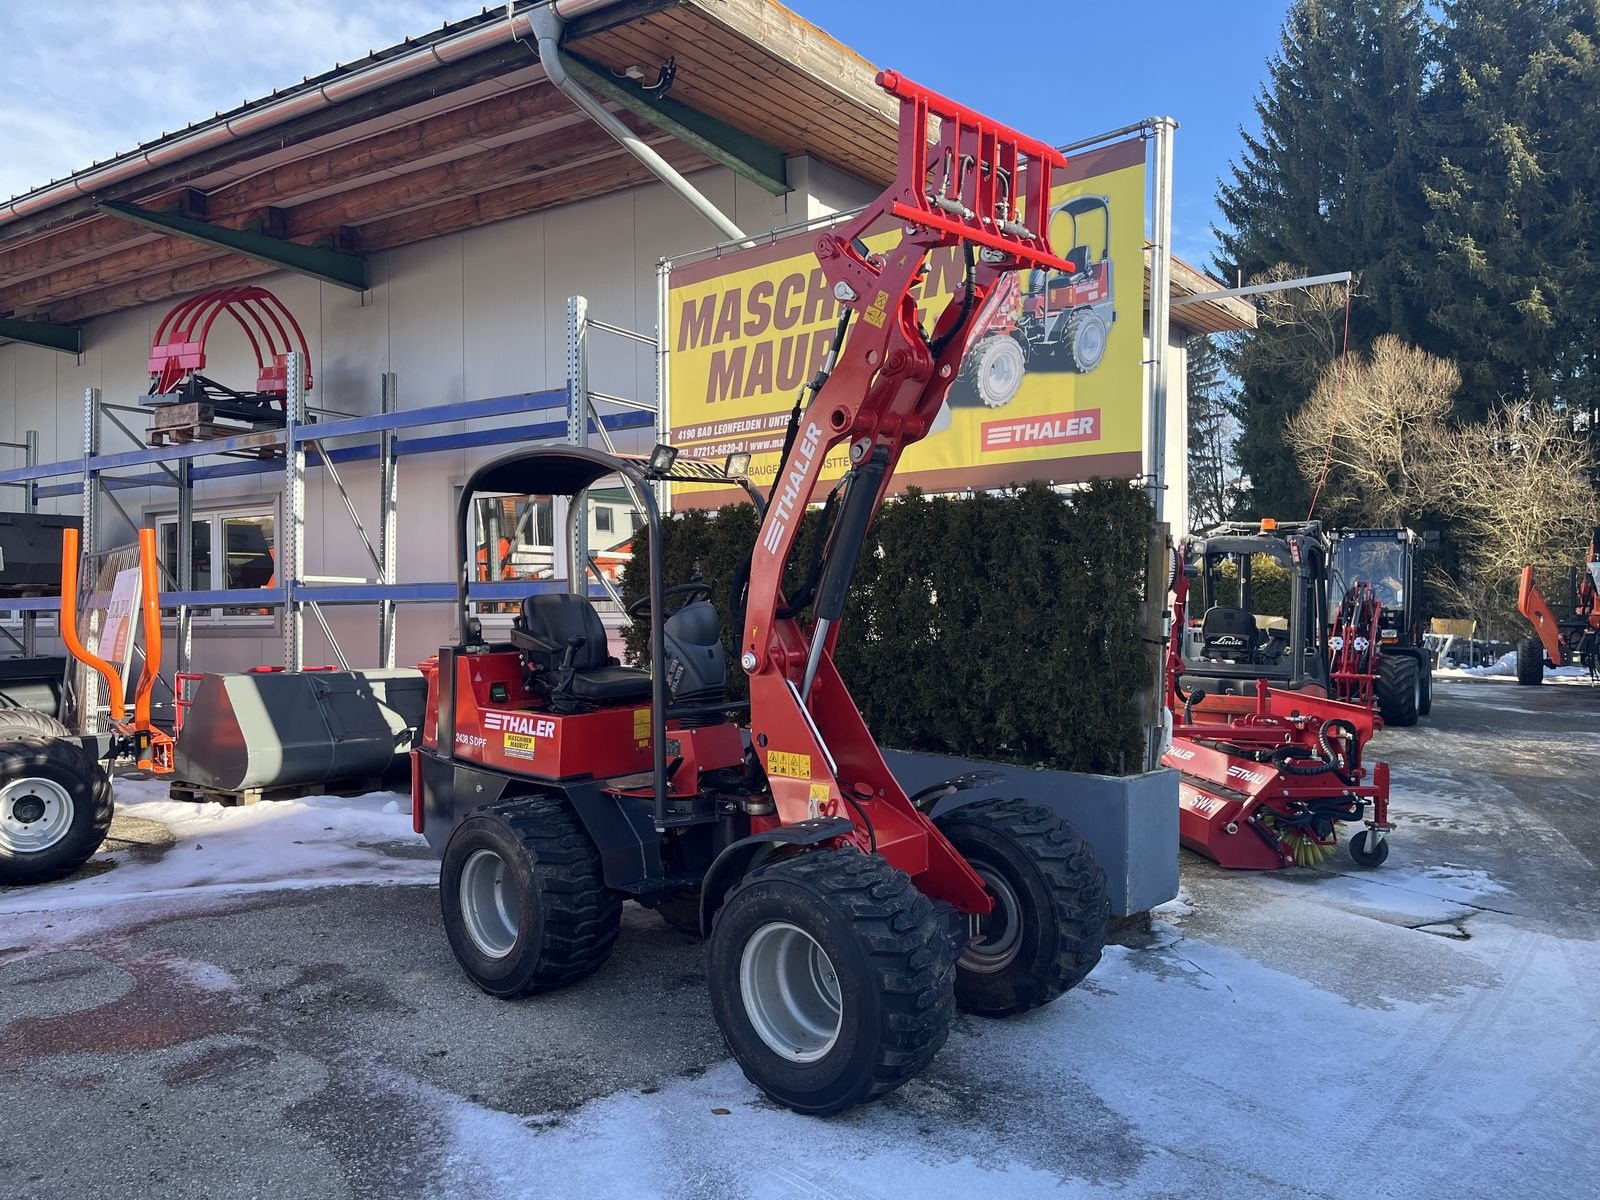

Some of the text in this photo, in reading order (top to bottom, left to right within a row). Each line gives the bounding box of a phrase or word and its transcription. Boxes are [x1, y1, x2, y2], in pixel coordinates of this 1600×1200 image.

[677, 246, 965, 352] MASCHN
[678, 429, 695, 441] 4190
[697, 426, 712, 438] BAD
[714, 420, 761, 435] LEONFELDEN
[1012, 416, 1094, 442] THALER
[693, 442, 743, 457] 07213-6820-0
[748, 464, 780, 476] BAUGE
[774, 422, 823, 521] THALER
[1210, 635, 1244, 646] Linde
[502, 715, 555, 738] THALER
[1166, 745, 1196, 761] HALER
